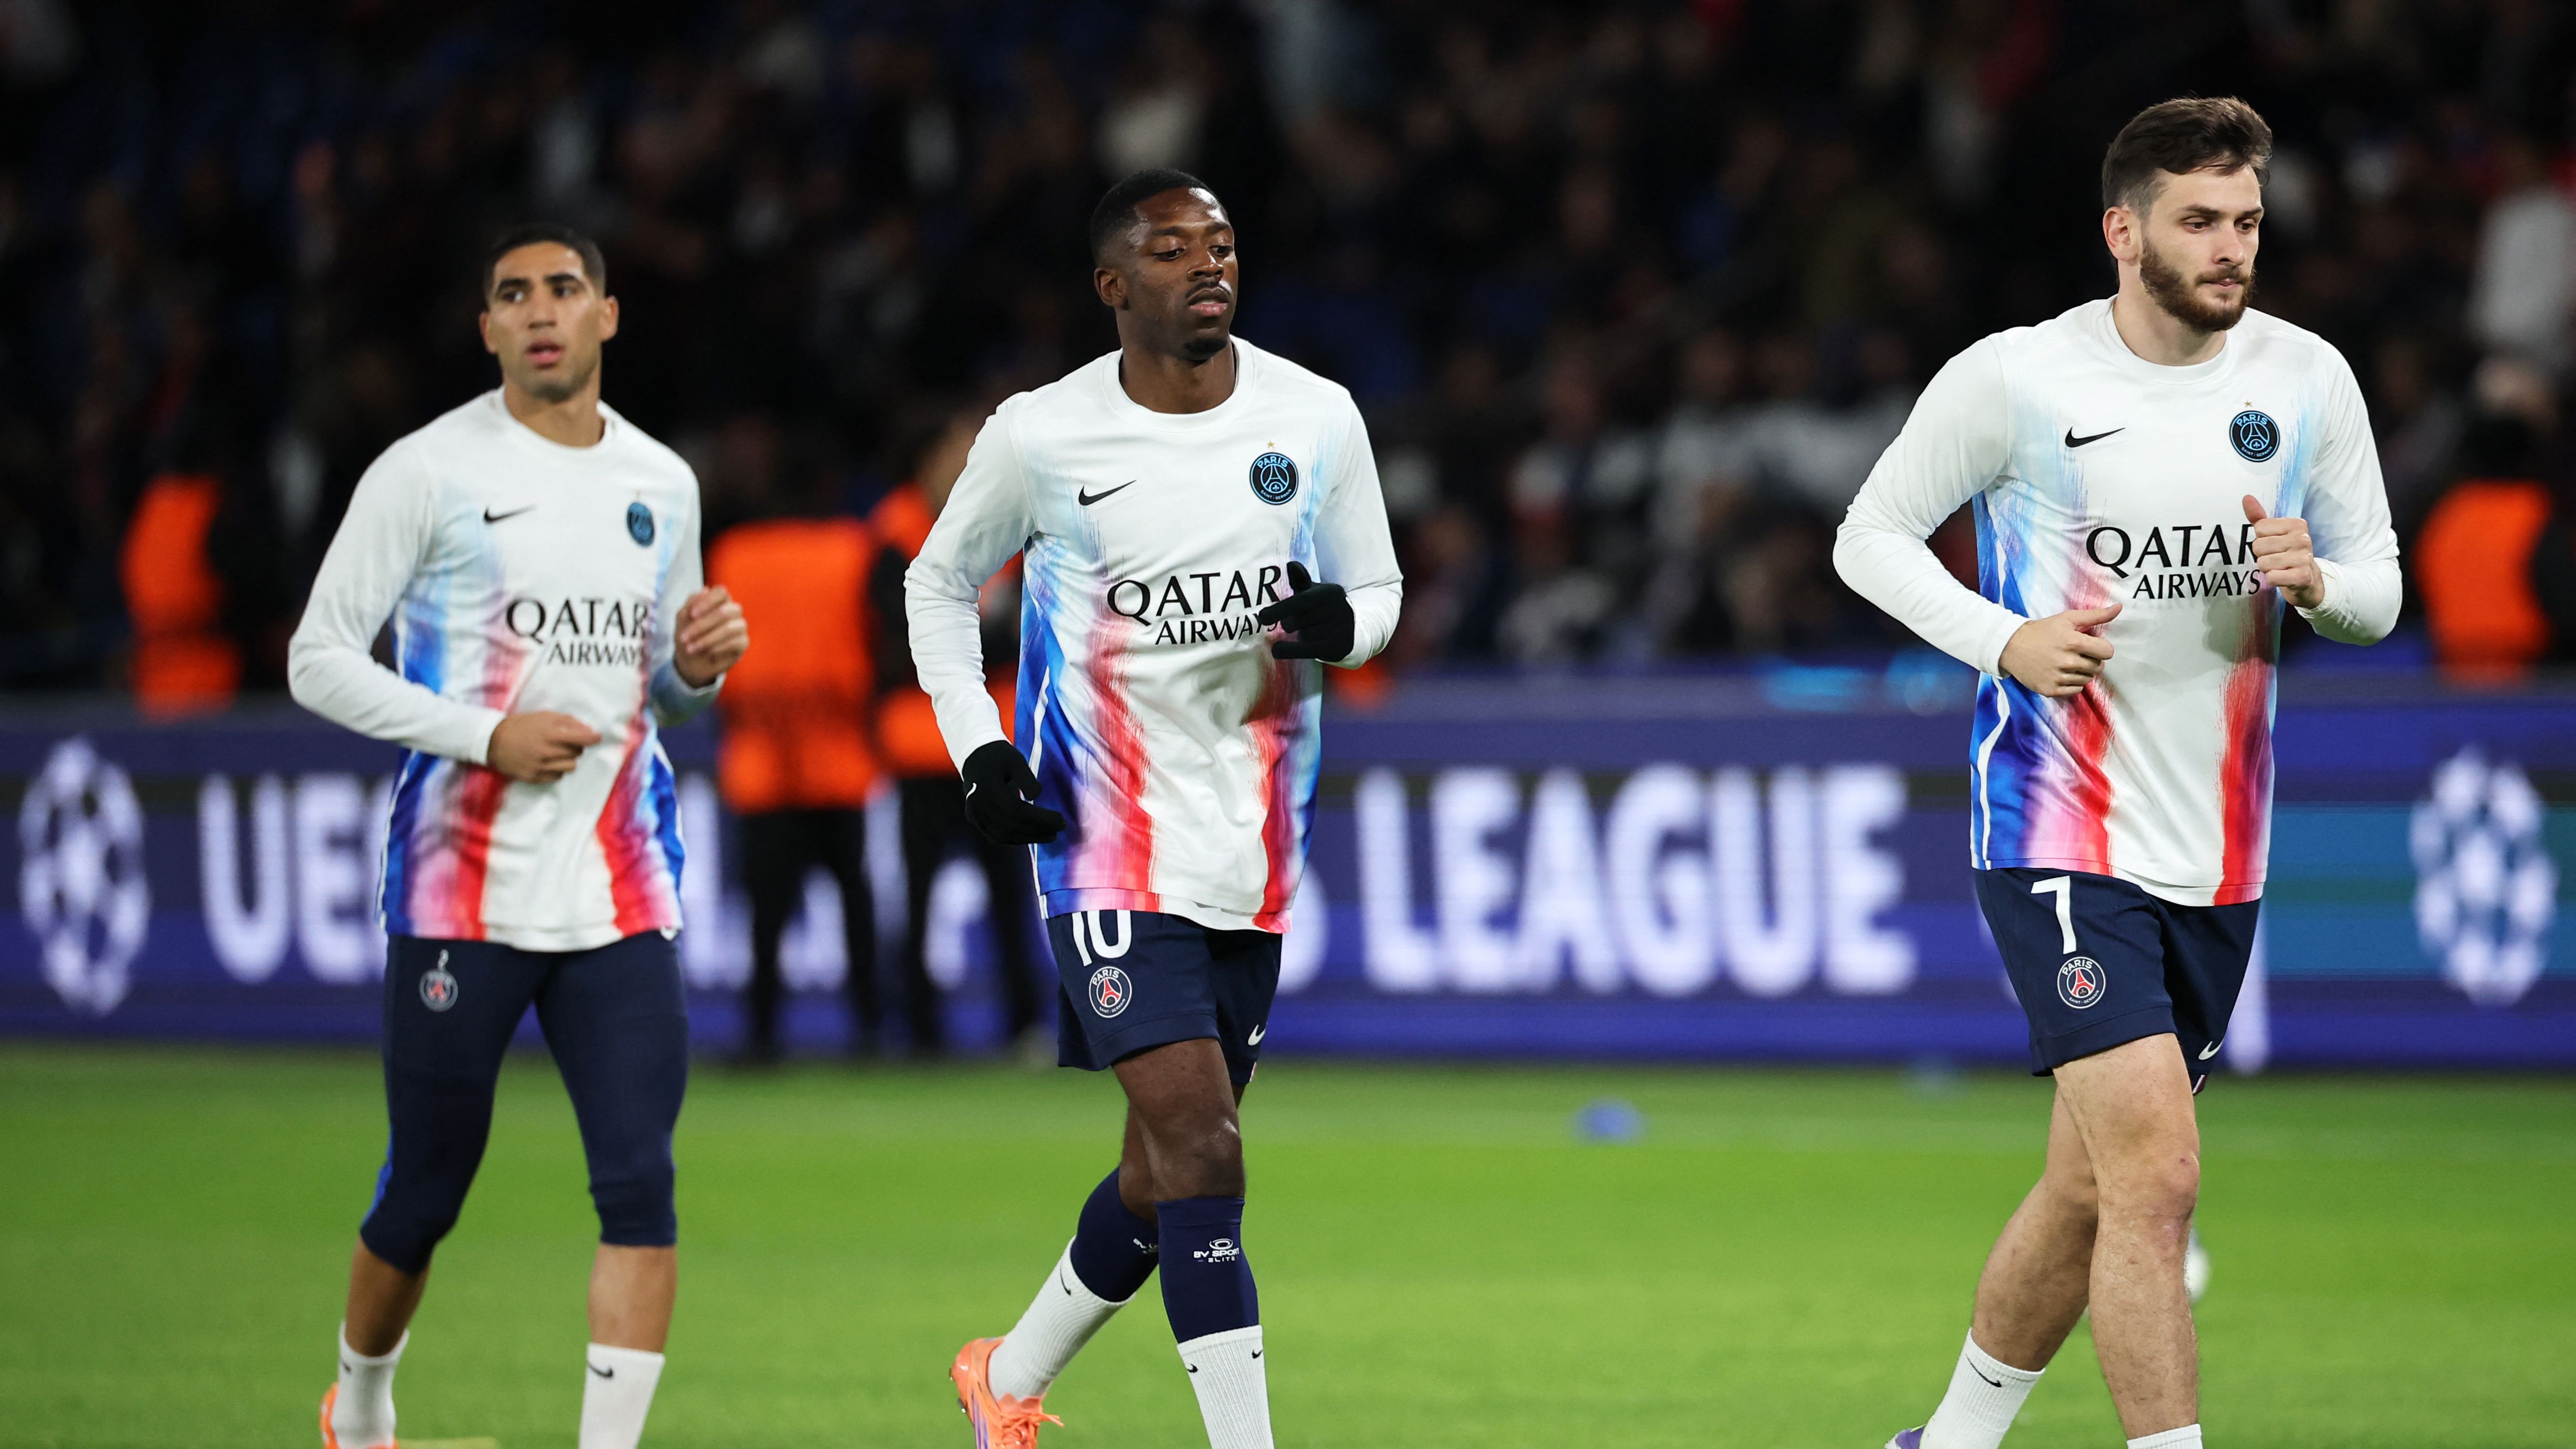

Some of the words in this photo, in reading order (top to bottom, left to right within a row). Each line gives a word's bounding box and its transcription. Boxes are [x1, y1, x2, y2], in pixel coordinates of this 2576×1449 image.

[2236, 414, 2268, 426] PARIS
[1257, 456, 1288, 469] PARIS
[2086, 524, 2257, 578] QATAR
[1107, 565, 1281, 626] QATAR
[2133, 569, 2261, 599] AIRWAYS
[505, 597, 647, 644] QATAR
[548, 642, 643, 665] AIRWAY
[1354, 761, 1916, 995] LEAGUE
[2031, 875, 2076, 954] 7
[1072, 910, 1132, 966] 10
[1092, 969, 1120, 986] PARIS
[2062, 959, 2093, 976] PARIS
[1212, 1247, 1239, 1257] SPORT
